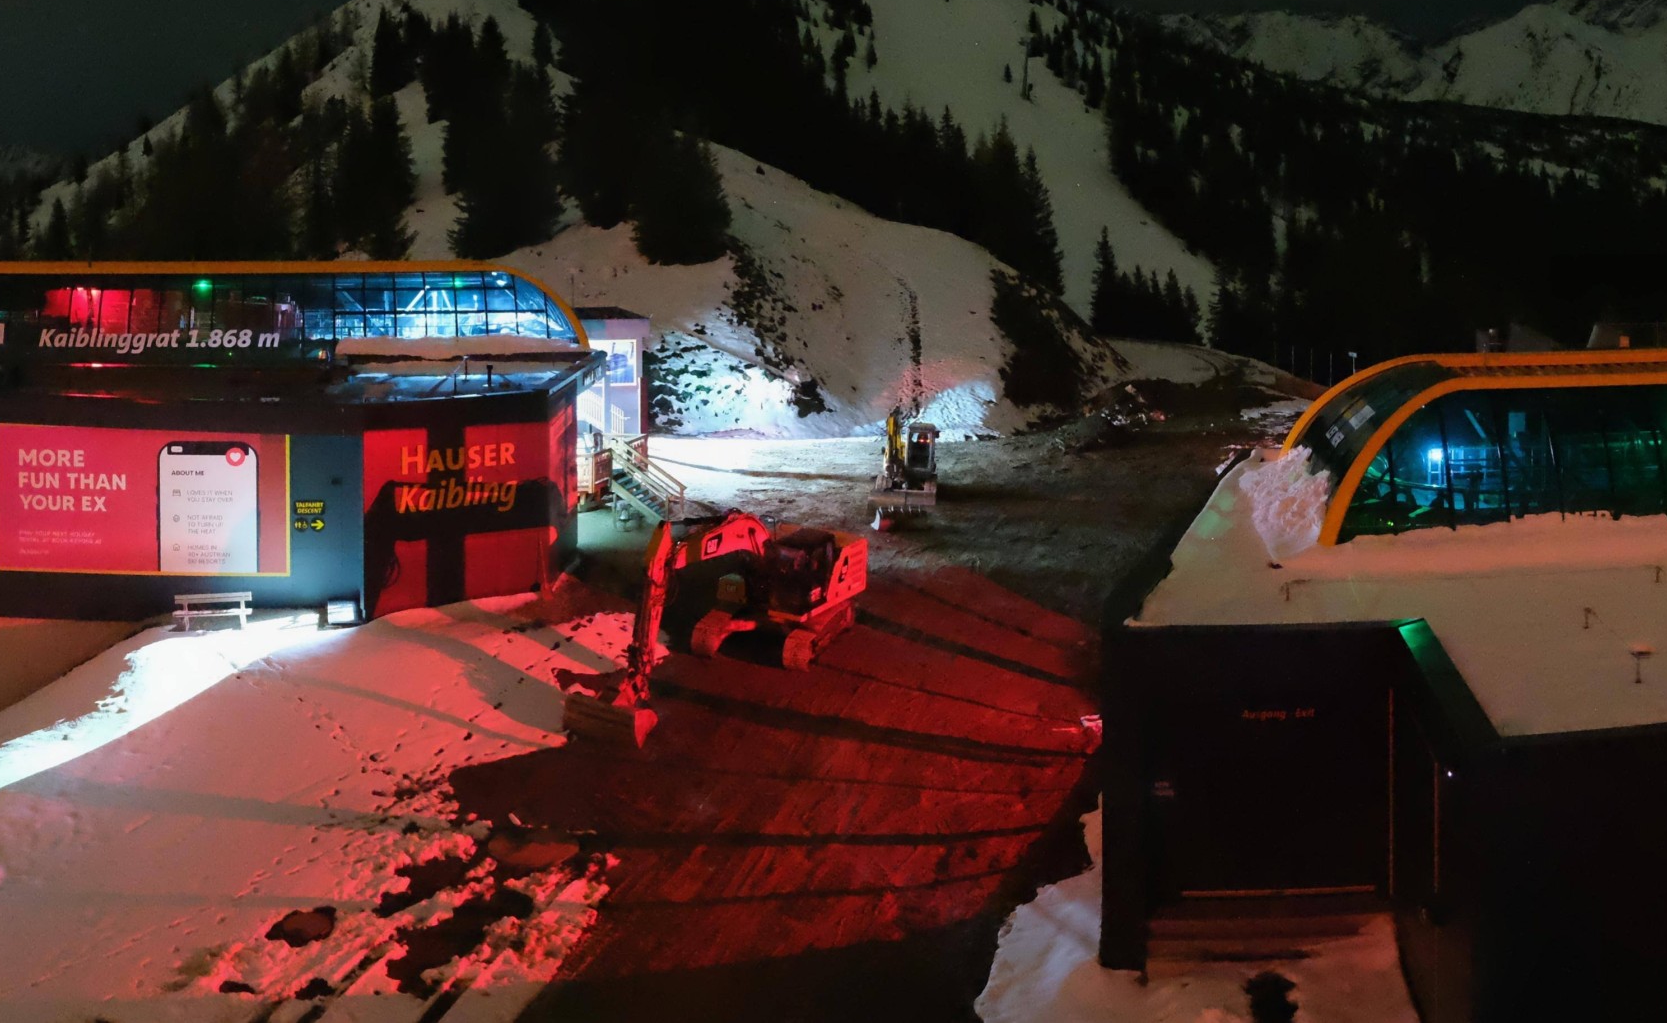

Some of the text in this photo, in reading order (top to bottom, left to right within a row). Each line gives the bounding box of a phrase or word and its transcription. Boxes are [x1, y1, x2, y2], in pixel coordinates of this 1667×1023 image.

[39, 327, 280, 354] Kaiblinggrat 1.868 m
[18, 448, 85, 467] MORE
[401, 442, 516, 475] HAUSER
[18, 472, 127, 490] FUN THAN
[19, 494, 107, 512] YOUR EX
[399, 475, 518, 514] Kaibling
